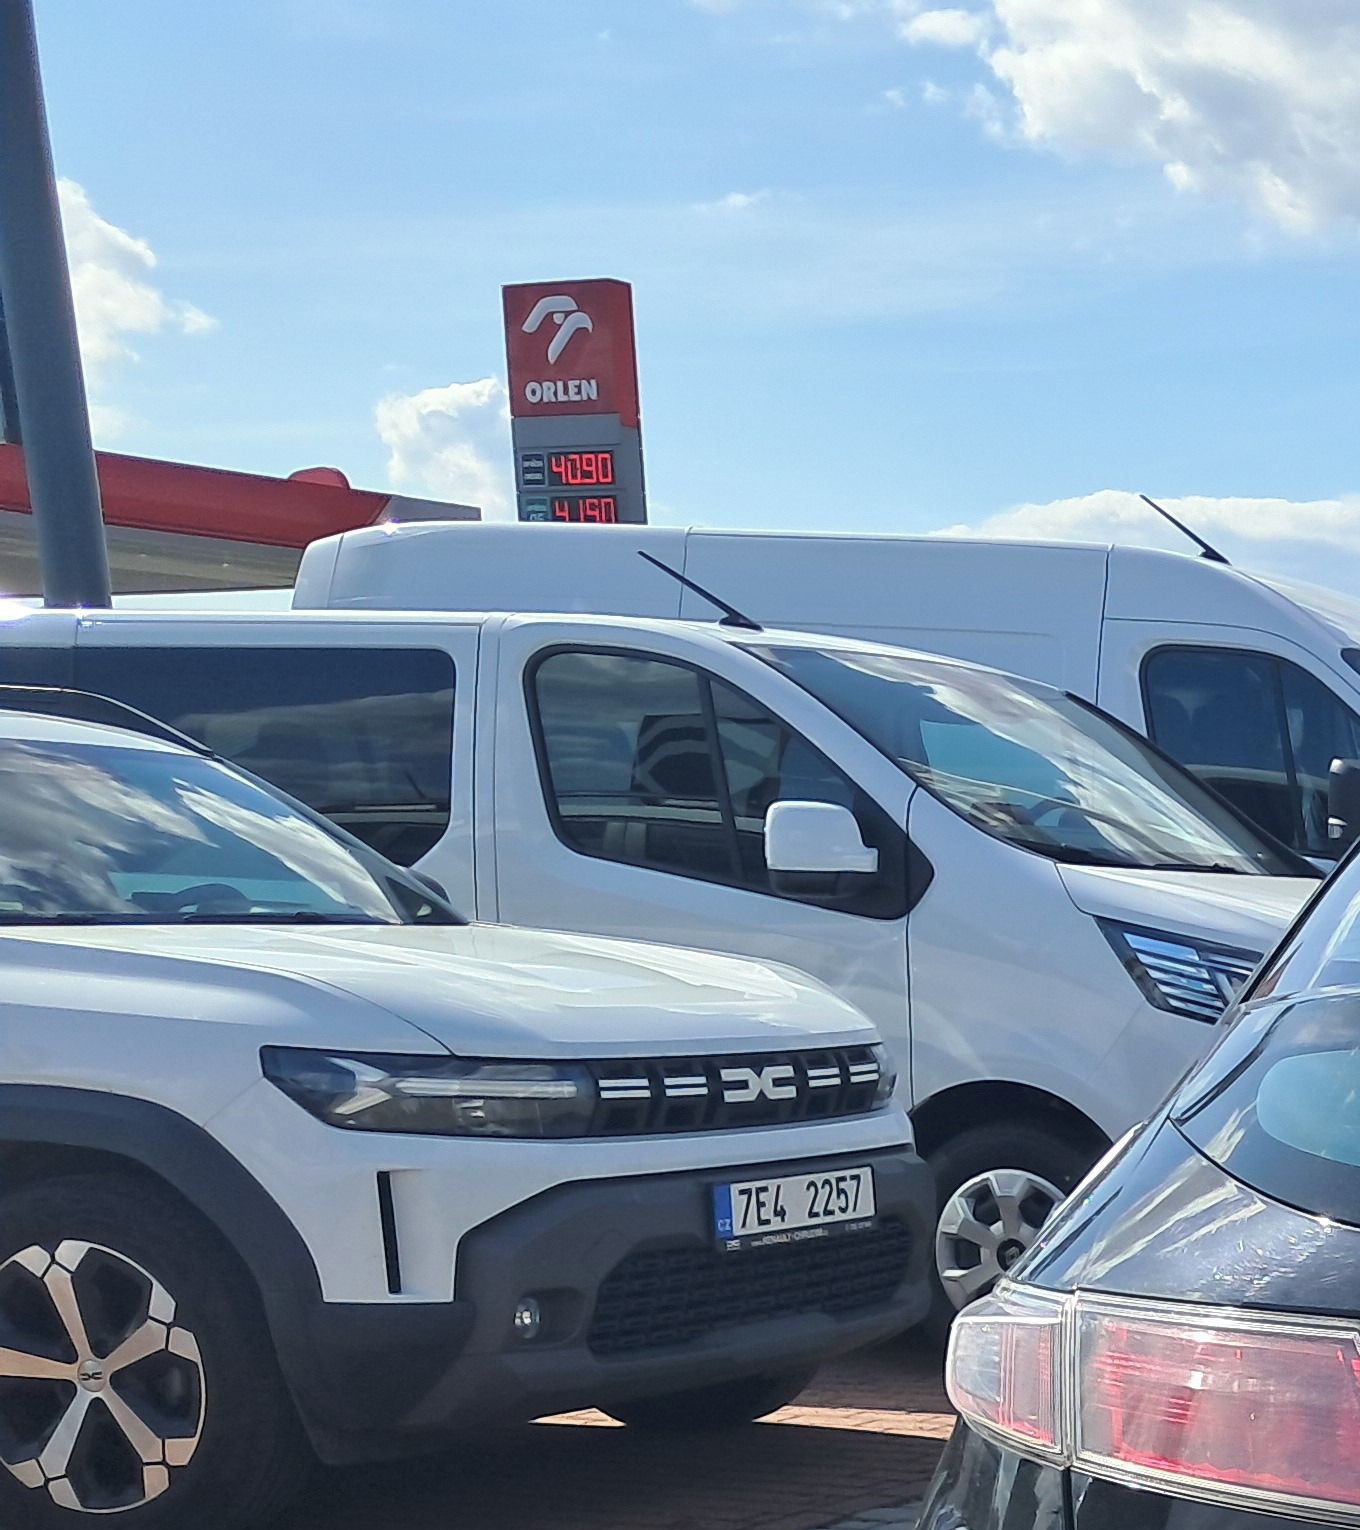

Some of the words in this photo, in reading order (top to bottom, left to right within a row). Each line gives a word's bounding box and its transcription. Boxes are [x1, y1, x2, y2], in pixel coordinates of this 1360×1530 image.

[525, 379, 598, 404] ORLEN
[738, 1184, 787, 1229] 7E4
[806, 1174, 861, 1219] 2257
[717, 1218, 731, 1232] CZ
